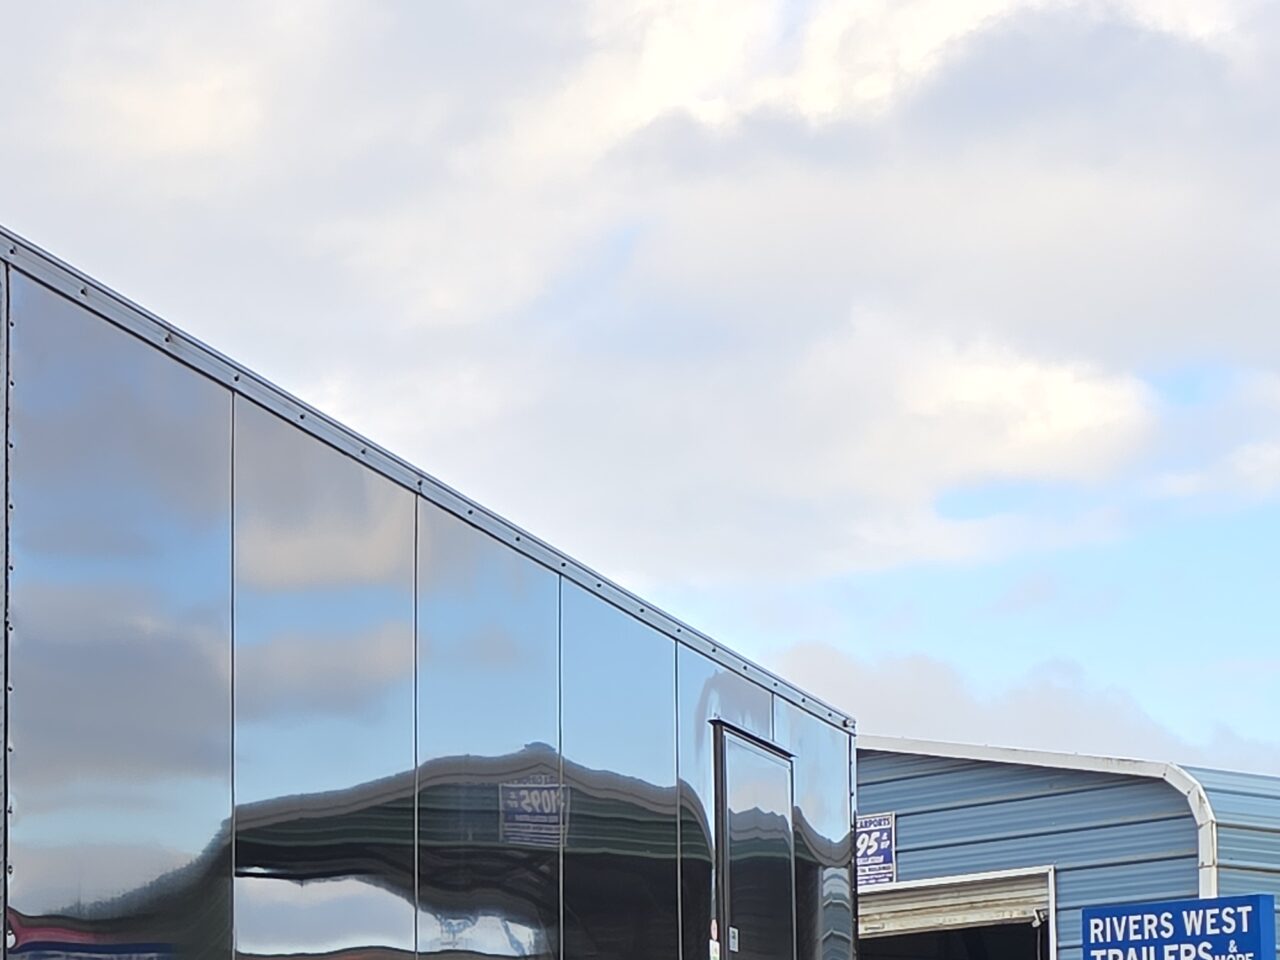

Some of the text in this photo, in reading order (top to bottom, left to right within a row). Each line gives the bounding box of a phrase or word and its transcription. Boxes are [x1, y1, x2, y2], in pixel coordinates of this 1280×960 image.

[1089, 905, 1253, 944] RIVERS WEST
[1228, 939, 1238, 953] &
